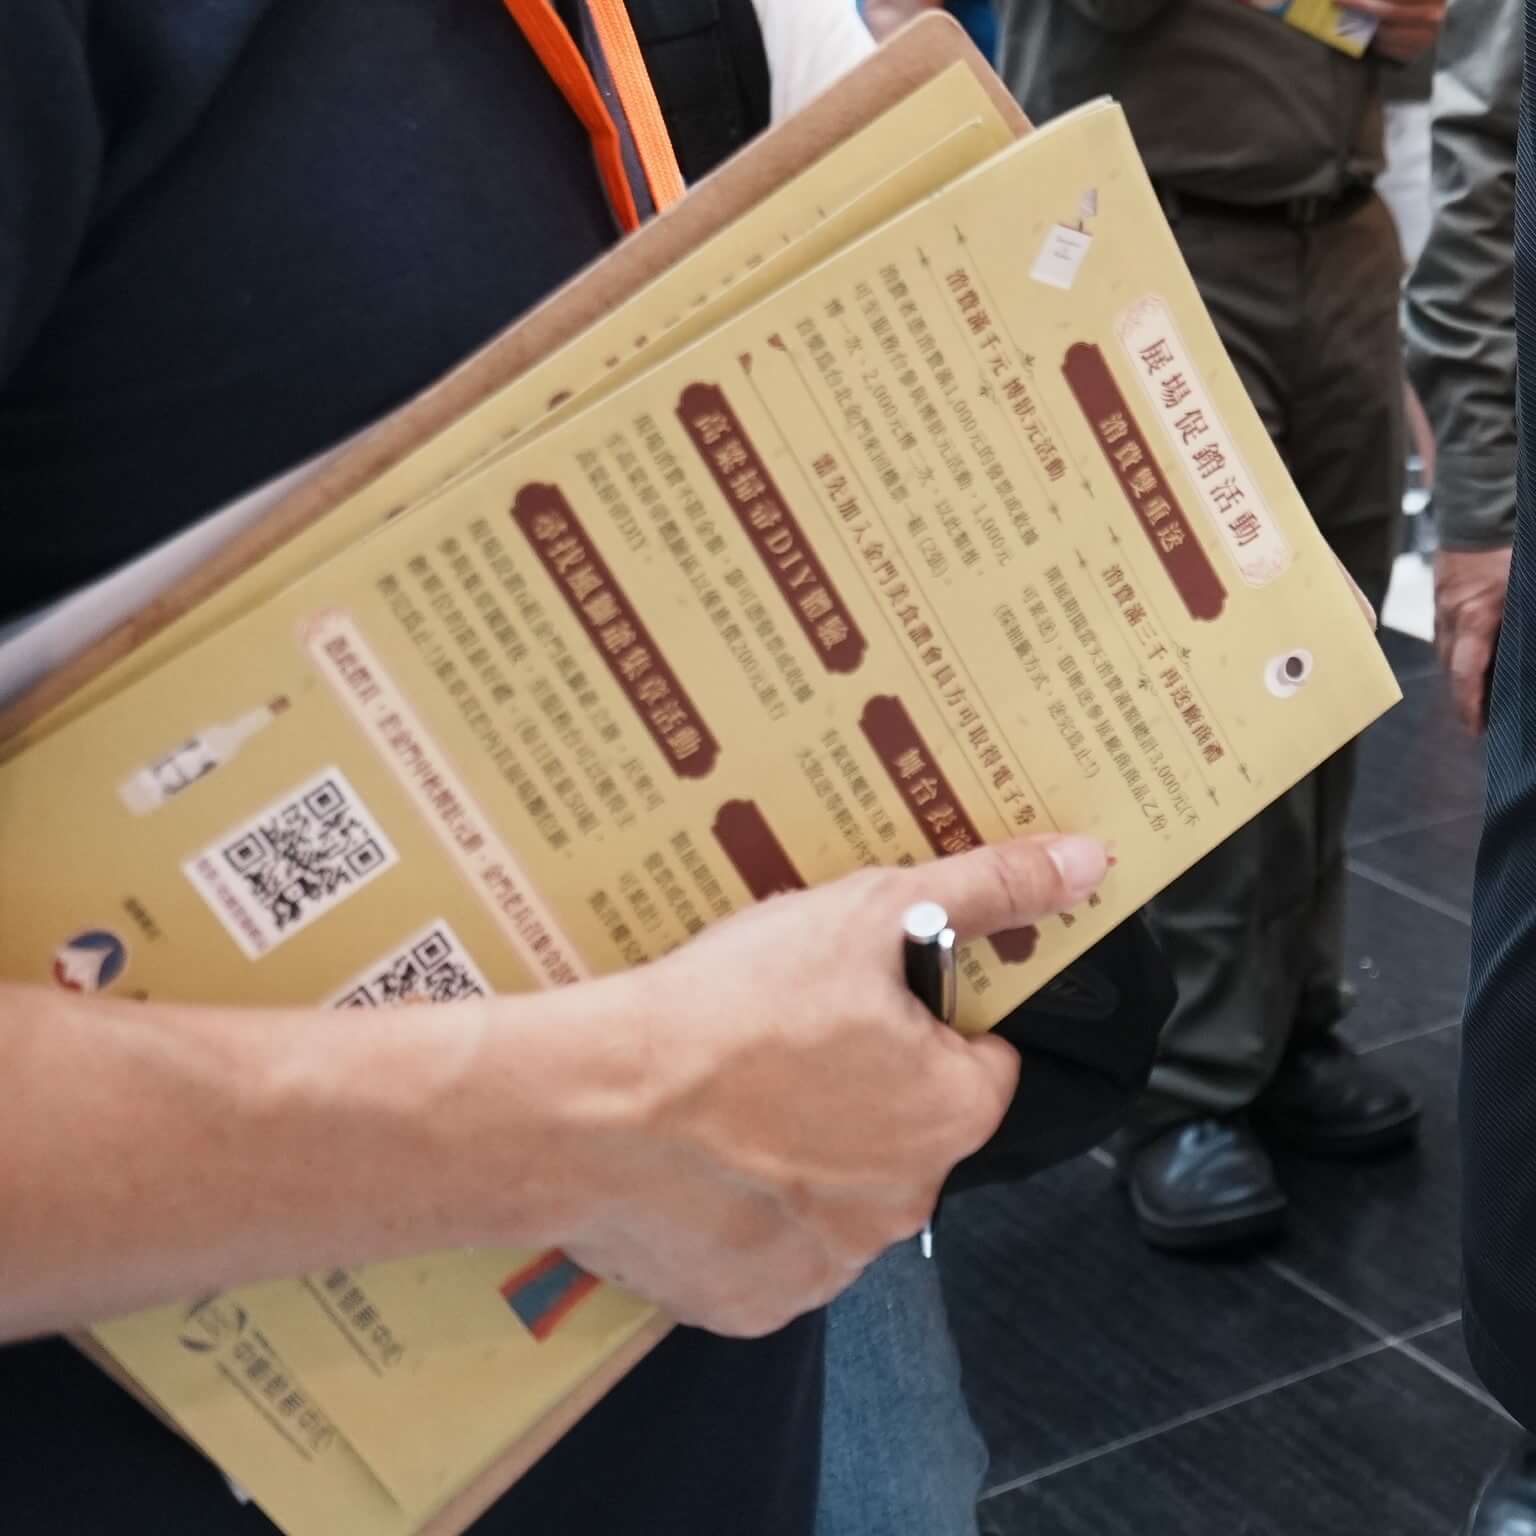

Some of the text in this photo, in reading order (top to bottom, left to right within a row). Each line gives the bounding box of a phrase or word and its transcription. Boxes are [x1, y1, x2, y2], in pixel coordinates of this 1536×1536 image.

[942, 265, 1013, 378] 消費滿千元
[1096, 410, 1190, 555] 消費雙重送
[1135, 336, 1267, 549] 展場促銷活動
[1099, 563, 1226, 766] 消費滿三千 再送廠商禮
